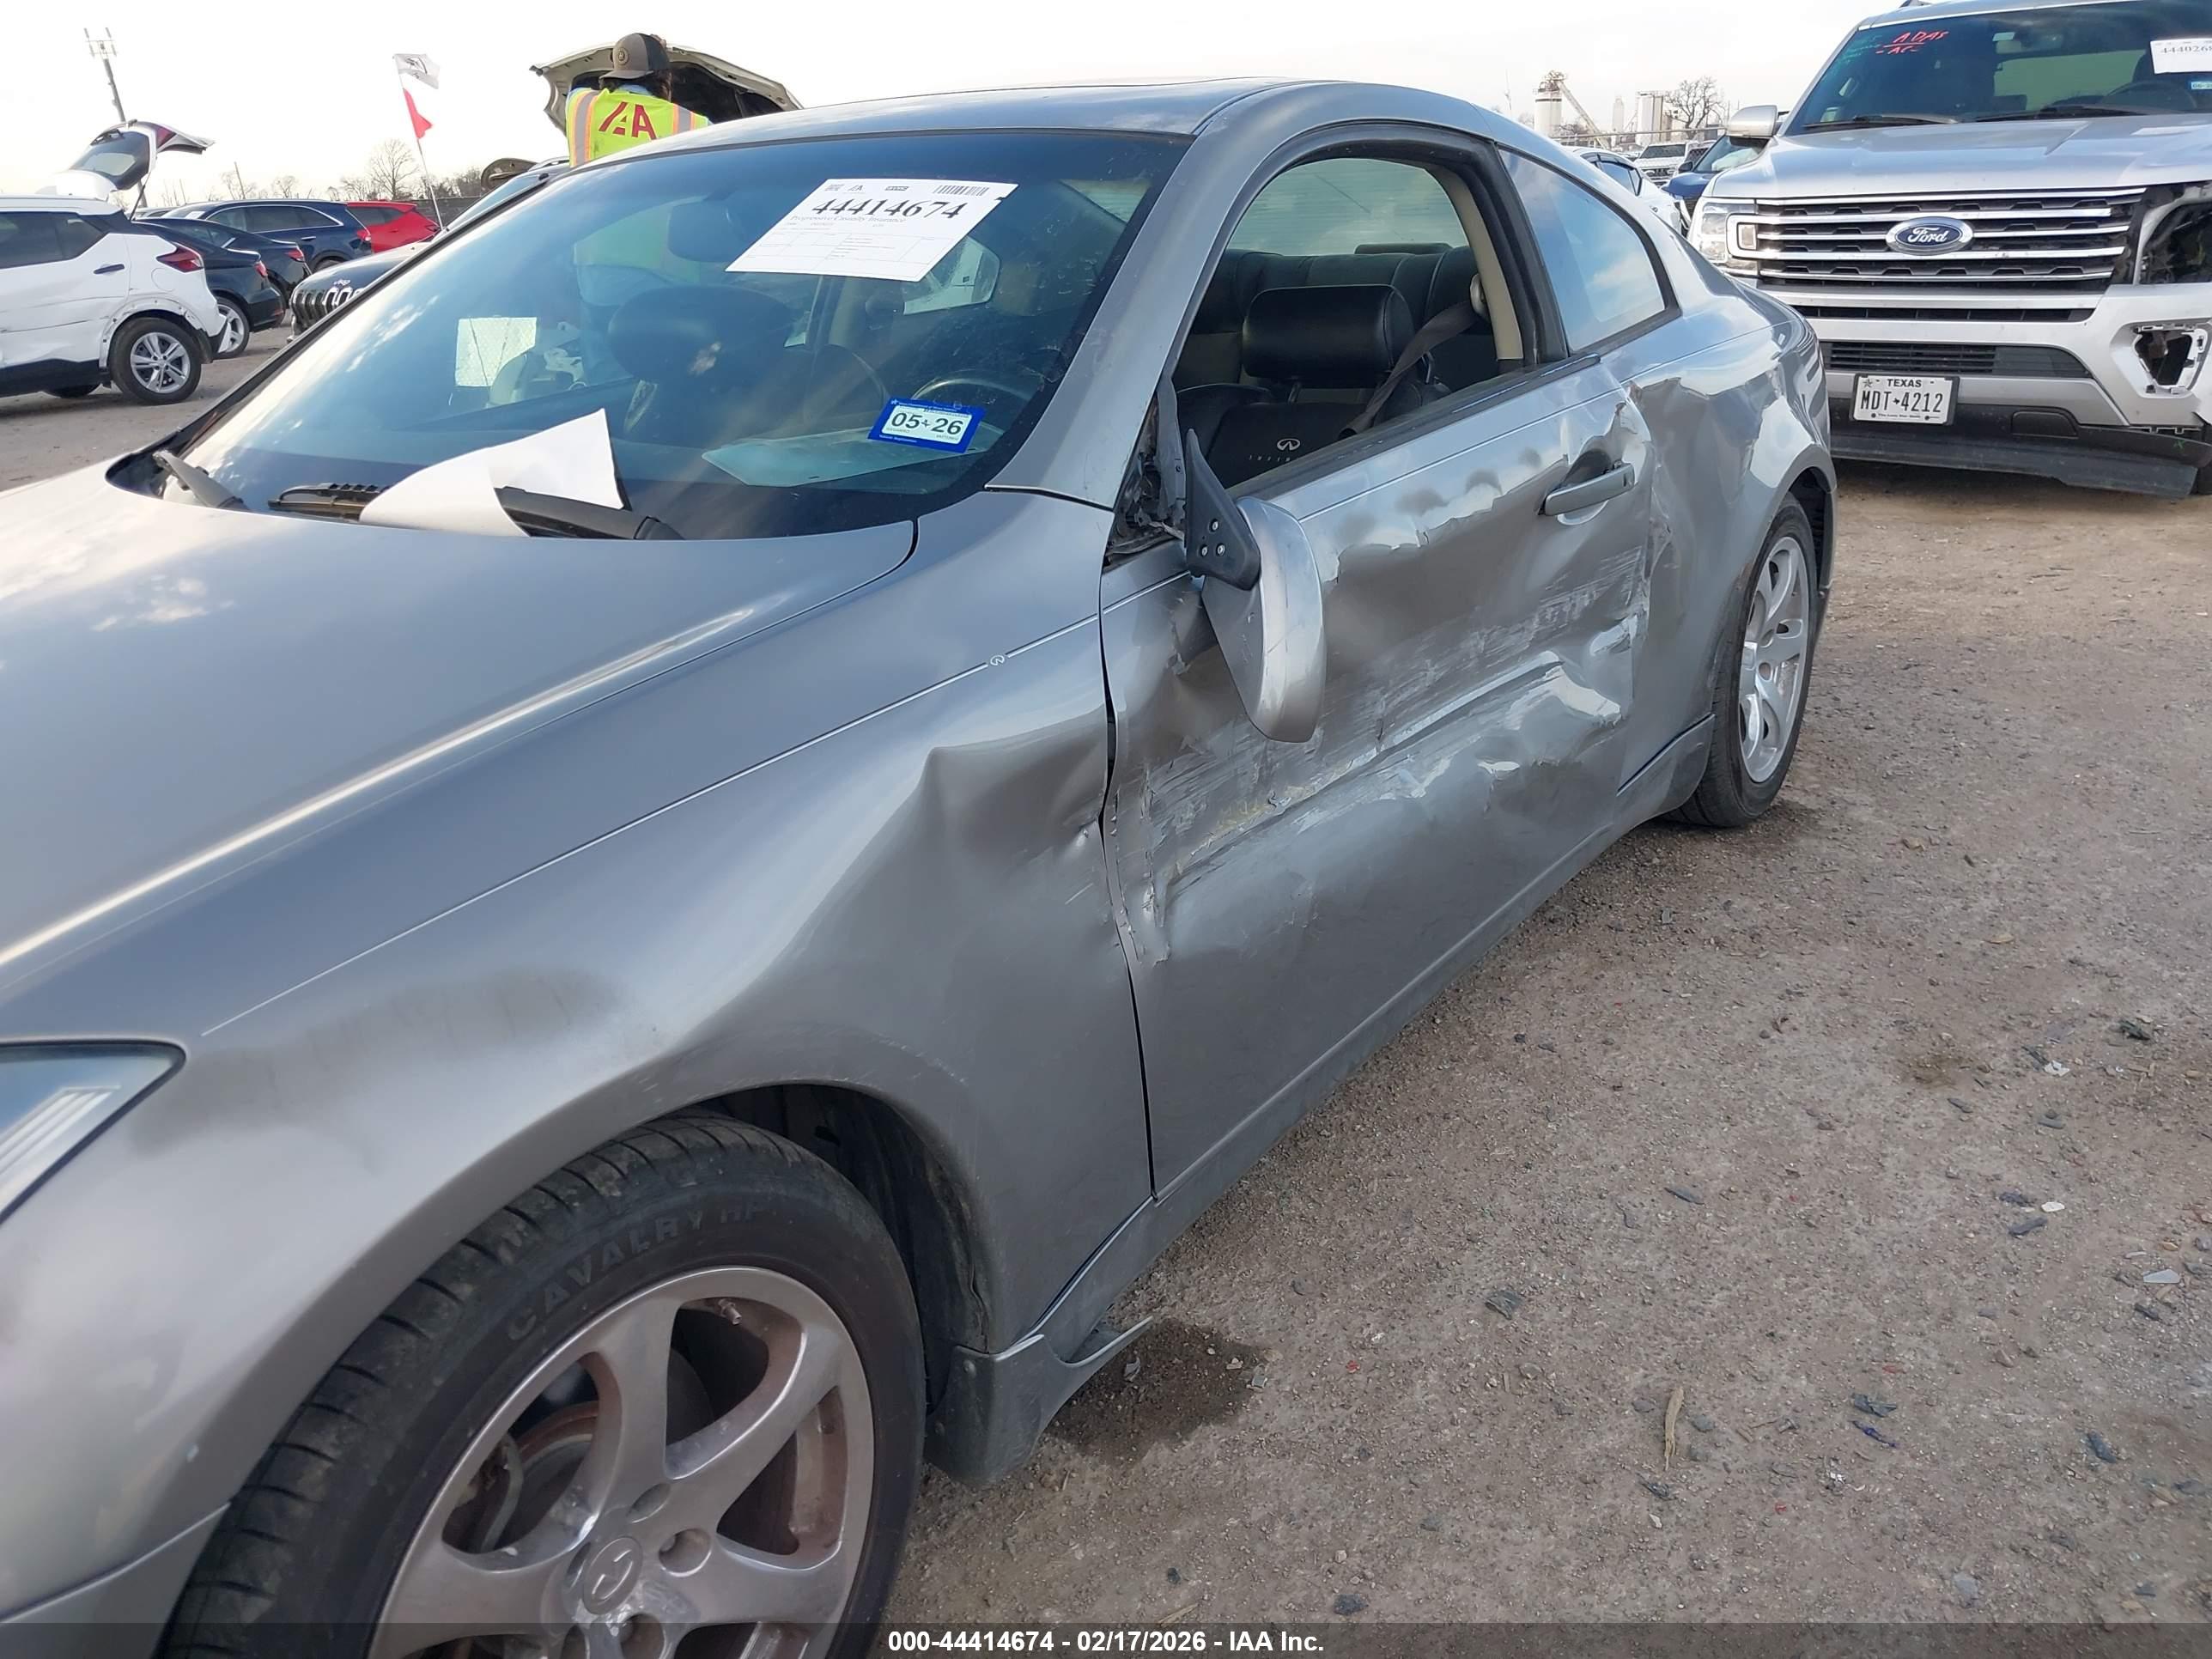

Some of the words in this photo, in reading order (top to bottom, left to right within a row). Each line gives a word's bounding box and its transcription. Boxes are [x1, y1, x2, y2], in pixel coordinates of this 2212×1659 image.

[812, 198, 968, 219] 44414674
[1907, 226, 1950, 244] Ford
[1887, 379, 1923, 388] TEXAS
